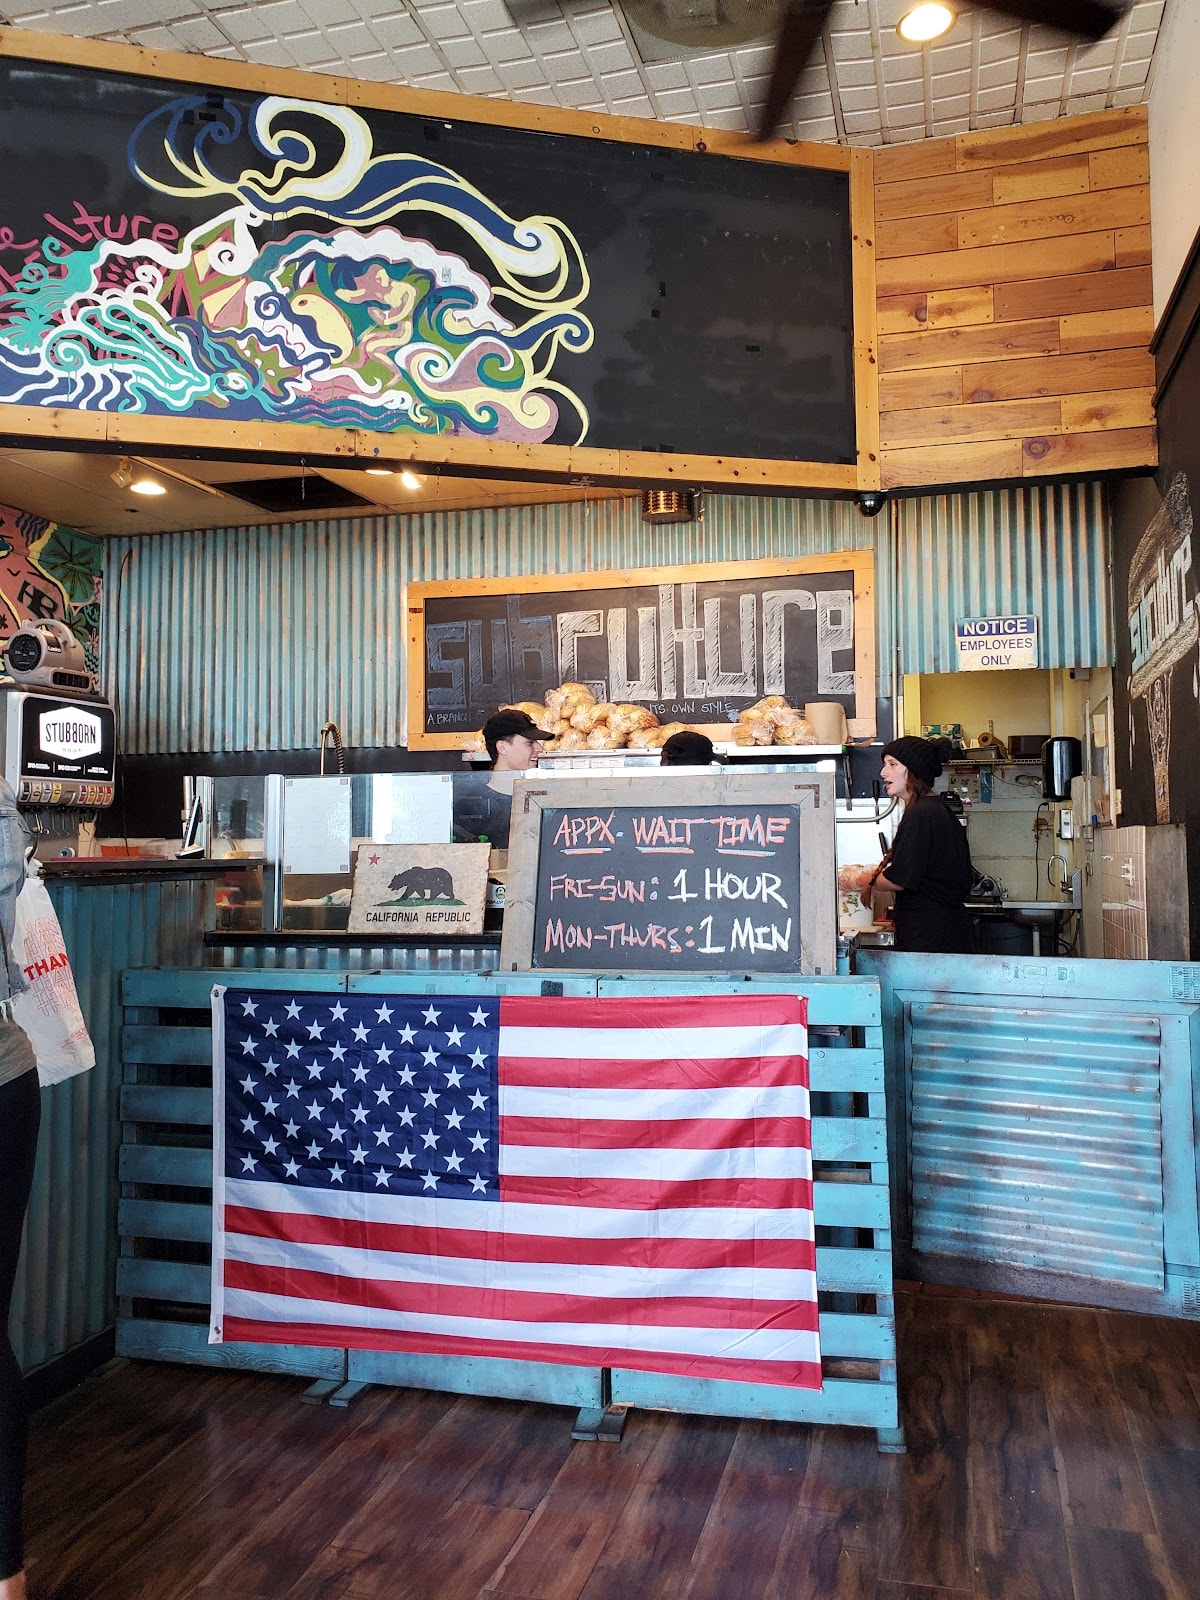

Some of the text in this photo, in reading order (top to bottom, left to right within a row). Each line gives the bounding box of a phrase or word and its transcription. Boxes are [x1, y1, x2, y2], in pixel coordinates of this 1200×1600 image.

[963, 618, 1028, 636] NOTICE
[960, 638, 1033, 651] EMPLOYEES
[981, 654, 1012, 666] ONLY
[649, 701, 733, 715] ITS OWN STYLE
[427, 714, 435, 725] A
[45, 722, 97, 744] STUBBORN
[632, 815, 705, 847] WAIT
[708, 814, 791, 848] TIME
[667, 868, 698, 903] 1
[704, 867, 789, 909] HOUR
[365, 912, 471, 923] CALIFORNIA REPUBLIC
[697, 914, 726, 954] 1
[730, 917, 793, 953] MIN
